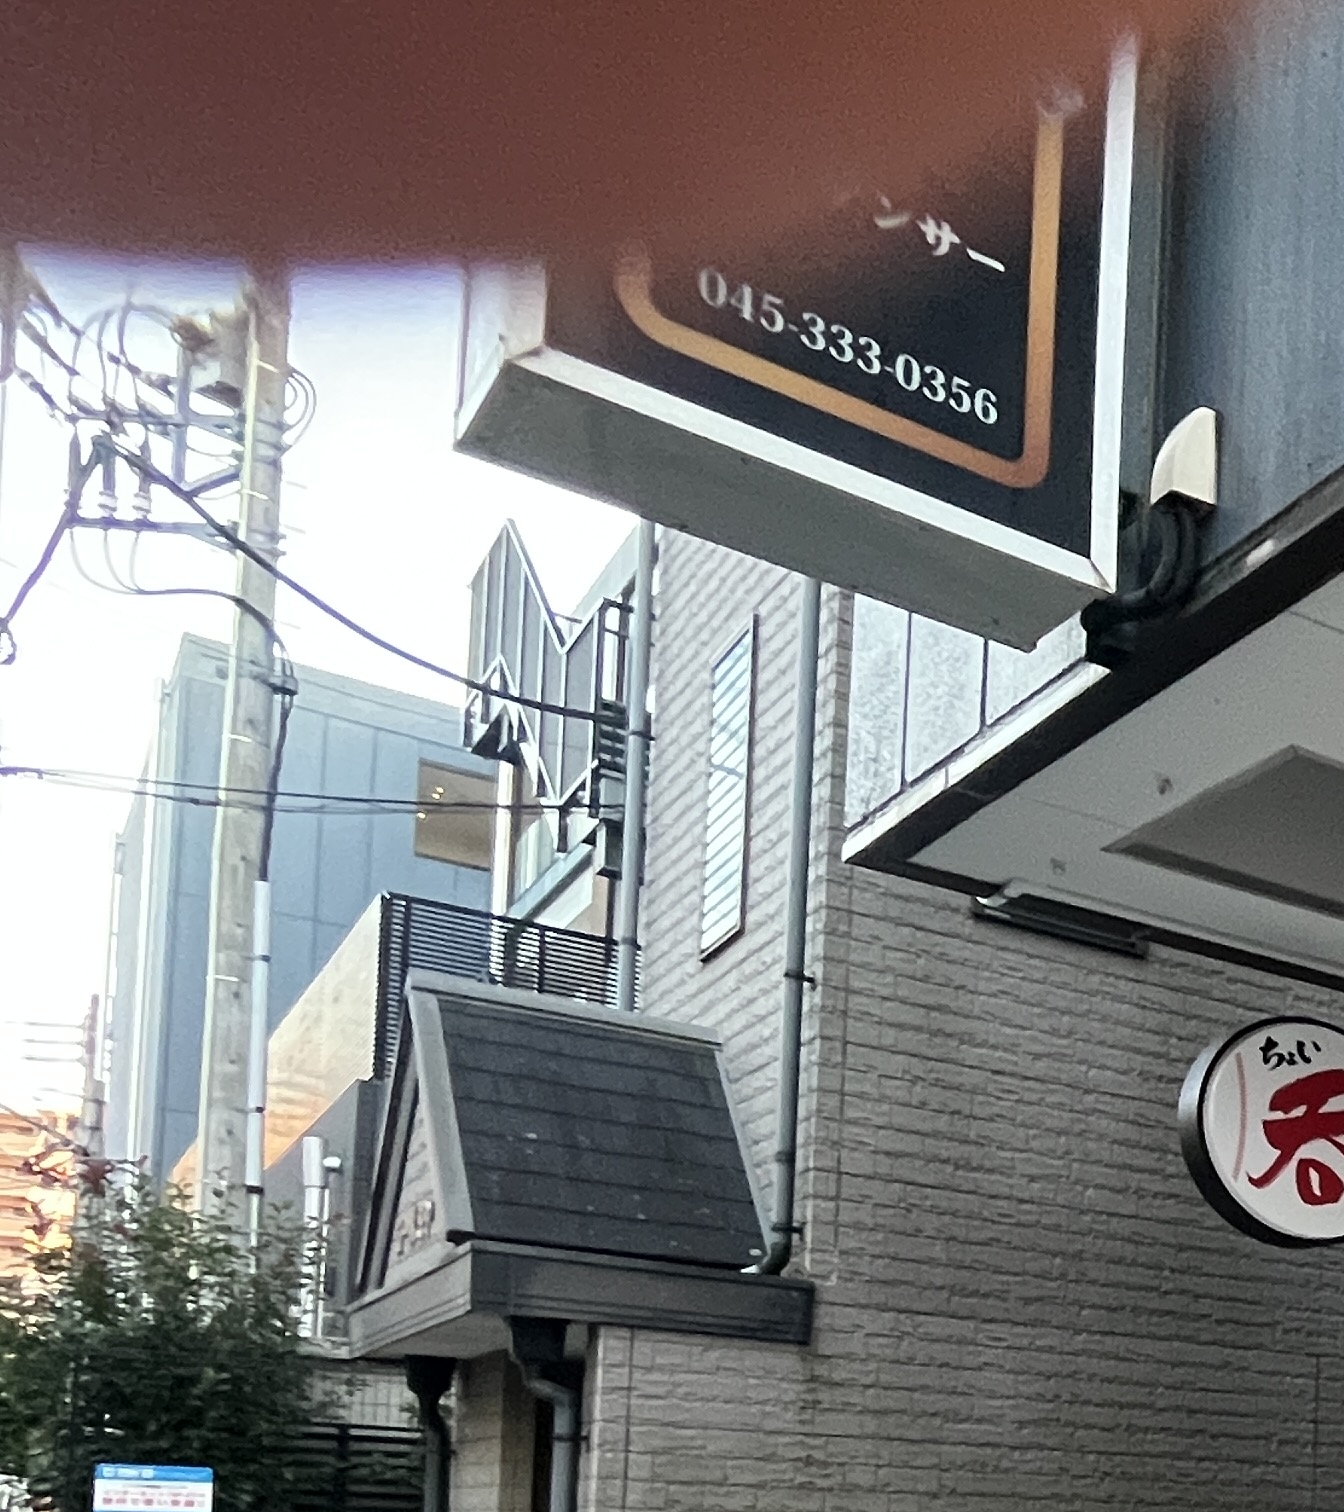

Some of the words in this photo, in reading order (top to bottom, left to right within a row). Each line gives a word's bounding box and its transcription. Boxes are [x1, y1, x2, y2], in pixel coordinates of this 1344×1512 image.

[696, 264, 1000, 428] 045-333-0356
[1259, 1035, 1323, 1071] ちょい
